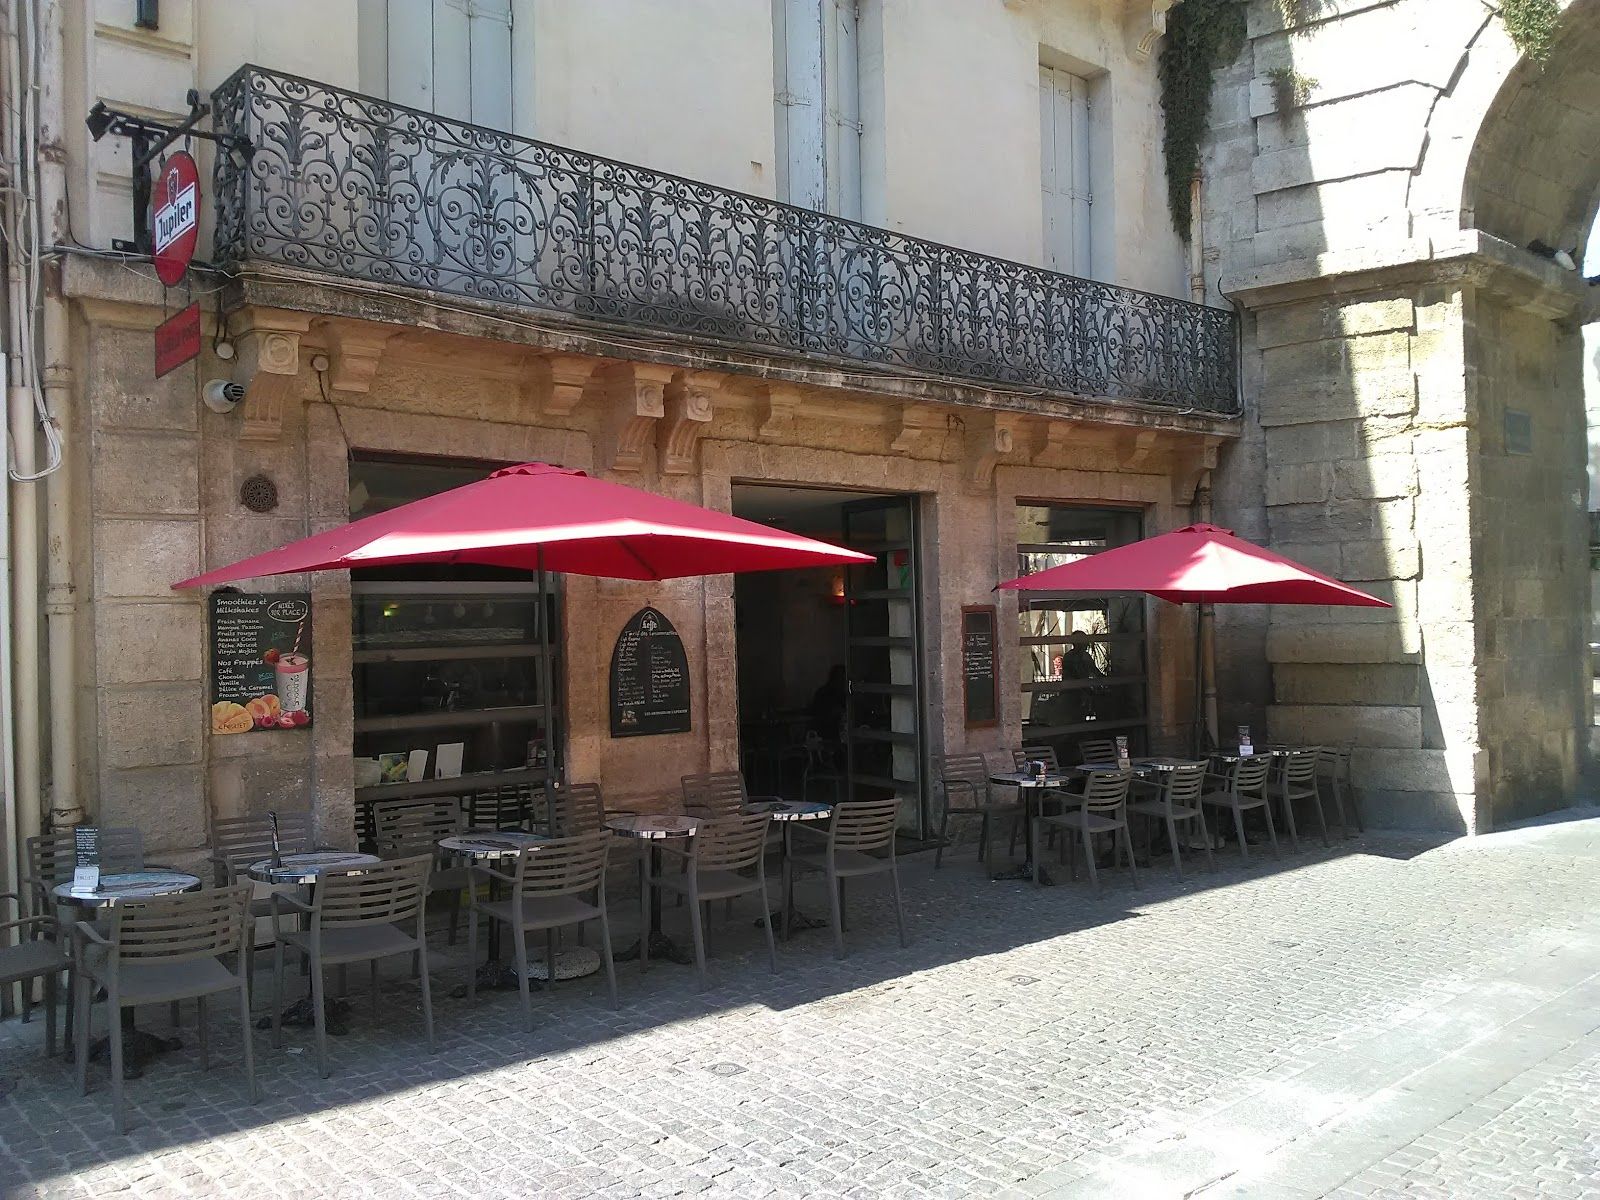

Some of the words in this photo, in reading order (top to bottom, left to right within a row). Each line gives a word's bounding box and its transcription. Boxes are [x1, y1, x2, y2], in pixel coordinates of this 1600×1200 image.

[157, 200, 192, 243] Jupiler
[216, 598, 256, 606] Smoothies
[282, 608, 300, 616] PLACE
[233, 658, 263, 668] Frappés
